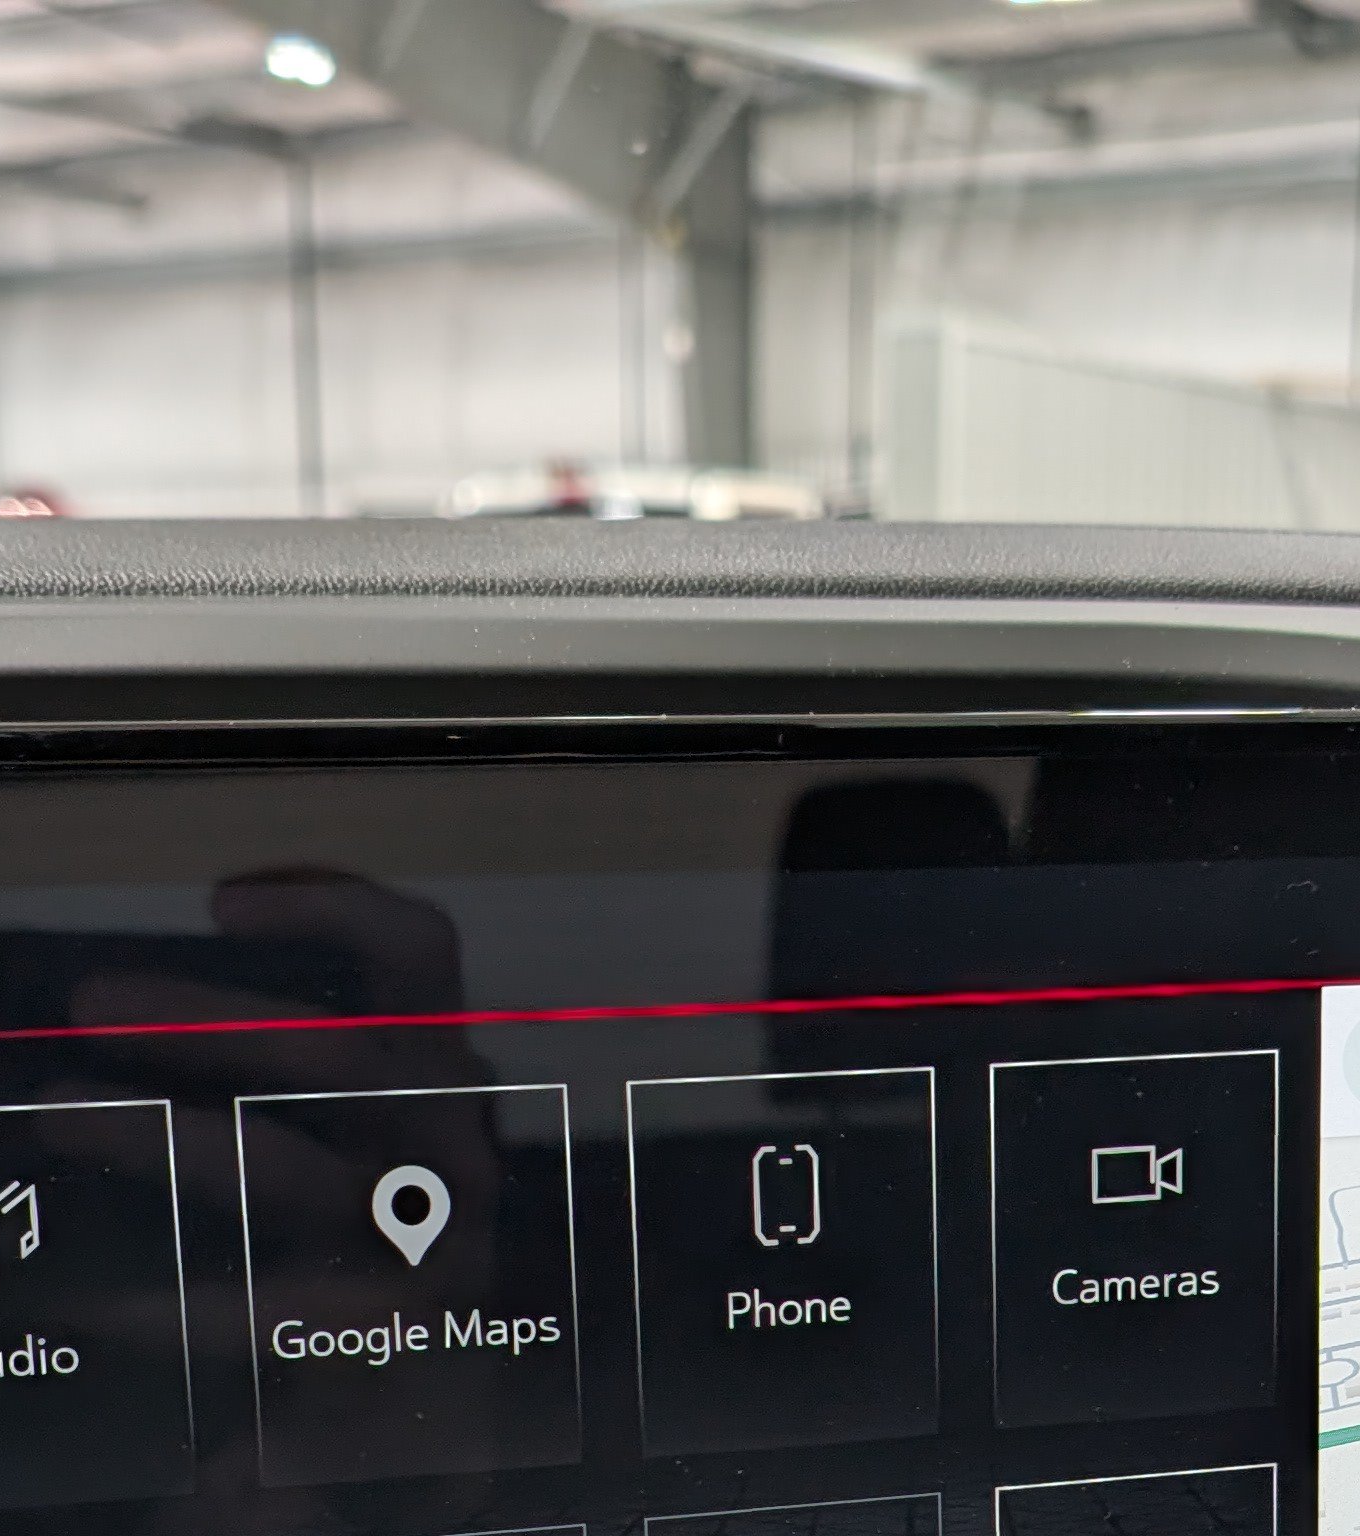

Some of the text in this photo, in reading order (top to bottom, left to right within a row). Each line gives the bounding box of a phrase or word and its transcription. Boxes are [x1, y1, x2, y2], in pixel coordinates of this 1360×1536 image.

[1052, 1268, 1220, 1305] Cameras
[727, 1288, 852, 1330] Phone
[272, 1308, 561, 1366] Google Maps
